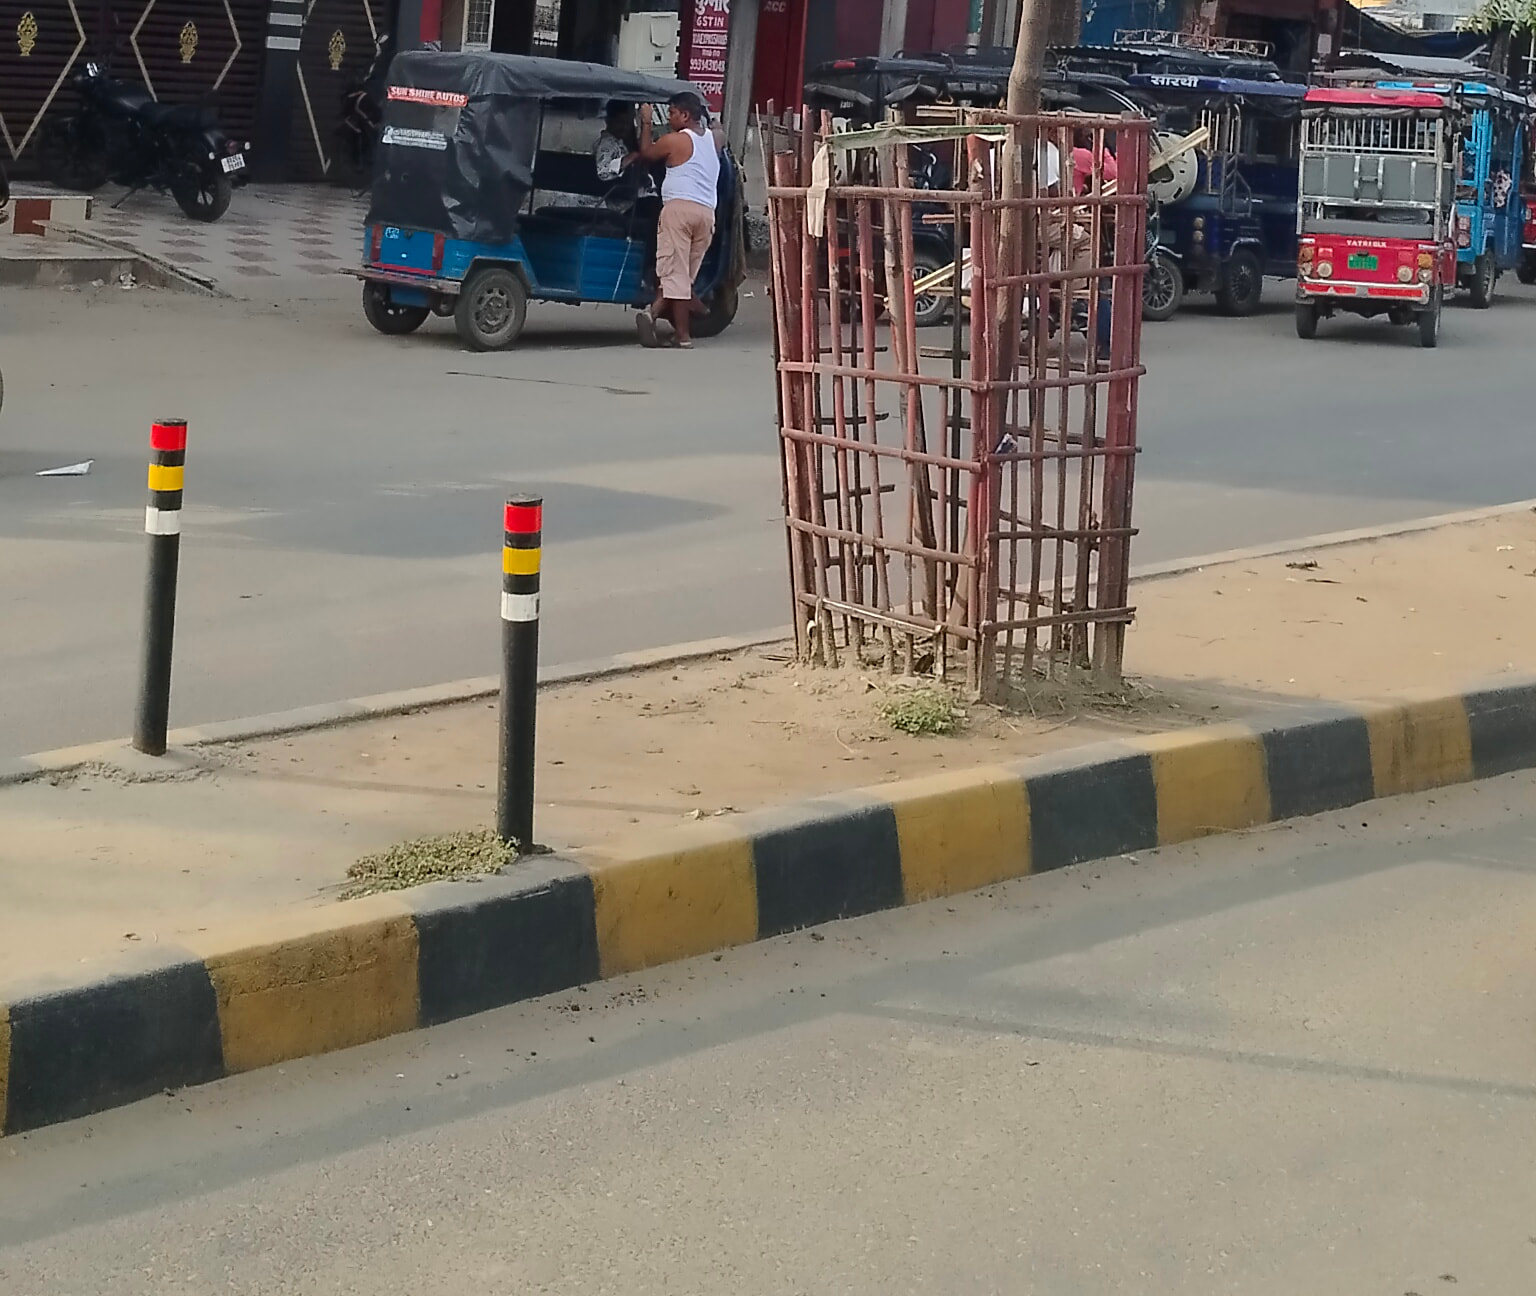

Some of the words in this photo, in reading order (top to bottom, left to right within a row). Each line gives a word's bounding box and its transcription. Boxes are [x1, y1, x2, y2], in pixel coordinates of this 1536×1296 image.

[696, 16, 724, 27] GSTIN
[1150, 75, 1199, 88] सारथी
[391, 87, 408, 97] SUN
[409, 88, 434, 99] SHINE
[436, 91, 465, 103] AUTOS
